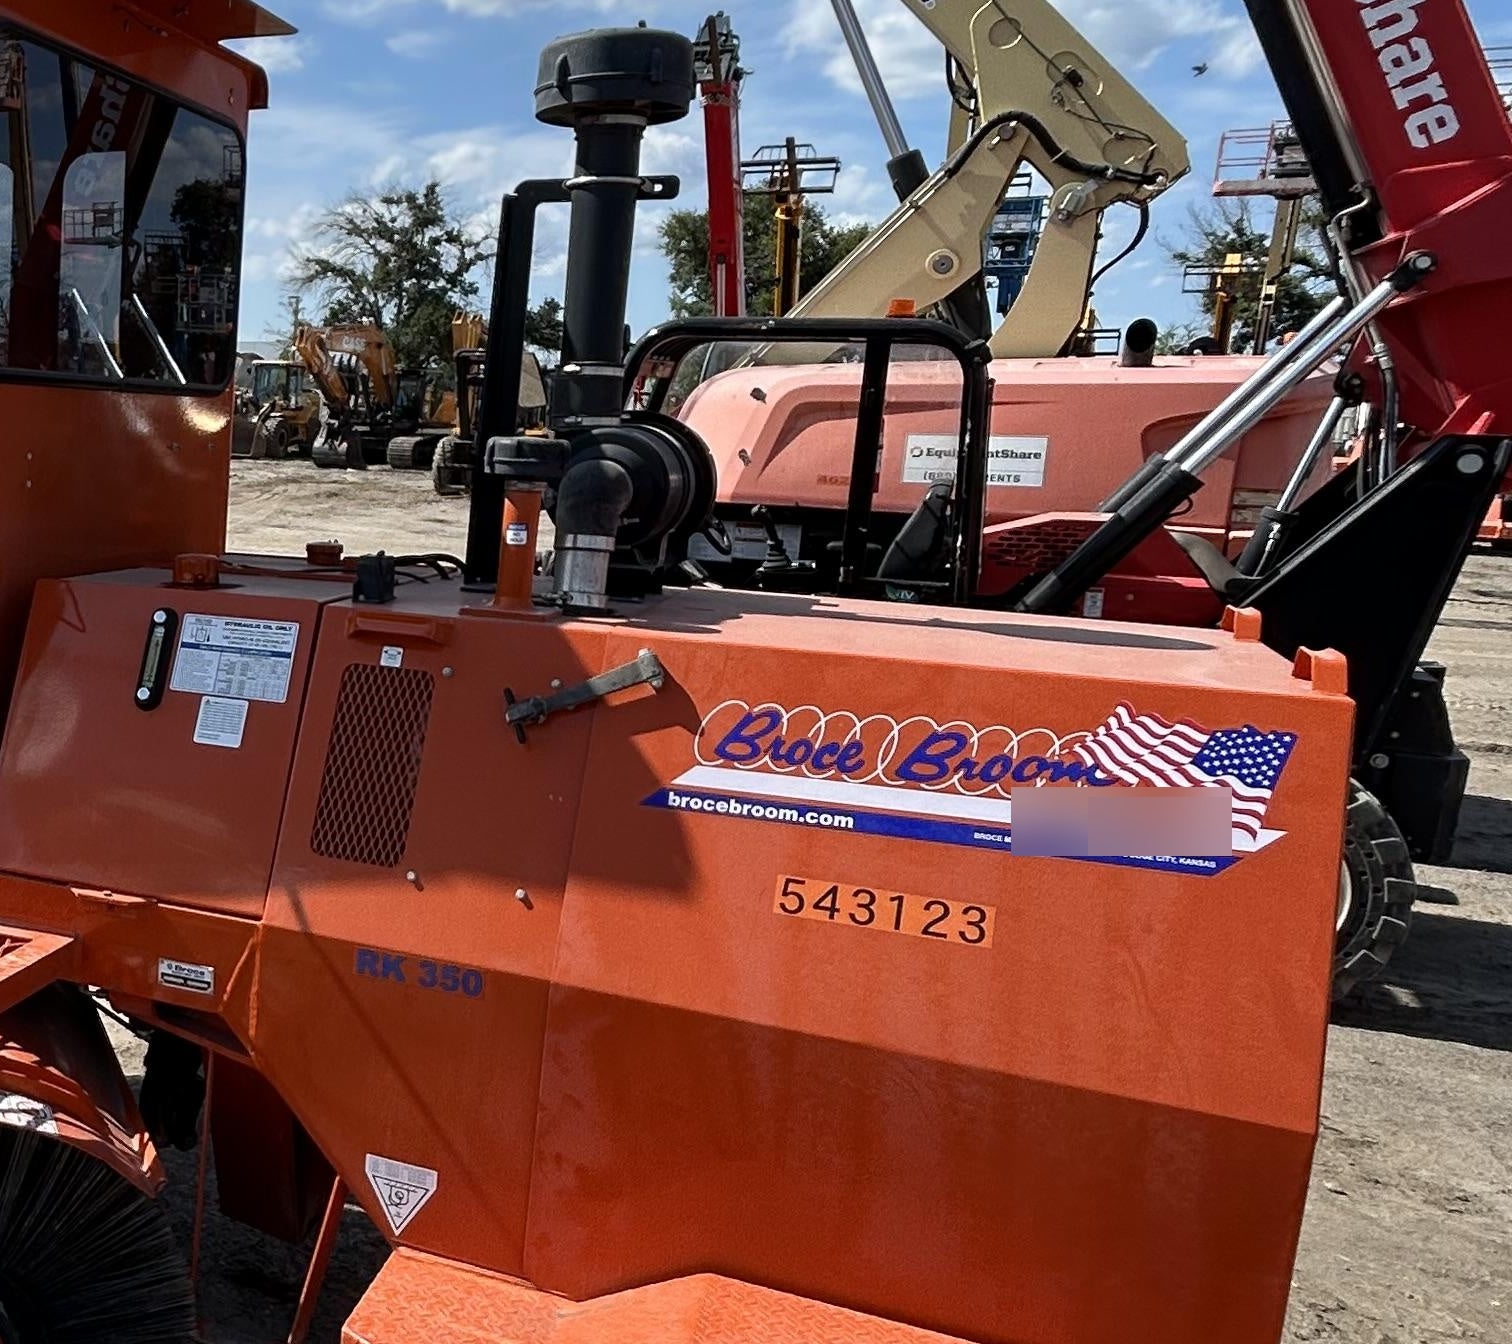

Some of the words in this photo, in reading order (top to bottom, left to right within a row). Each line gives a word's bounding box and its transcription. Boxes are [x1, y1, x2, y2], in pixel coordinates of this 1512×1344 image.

[713, 709, 866, 774] Broce
[895, 730, 1118, 787] Broom
[668, 792, 855, 830] brocebroom.com
[778, 876, 988, 945] 543123
[355, 947, 406, 983] RK
[418, 959, 484, 998] 350
